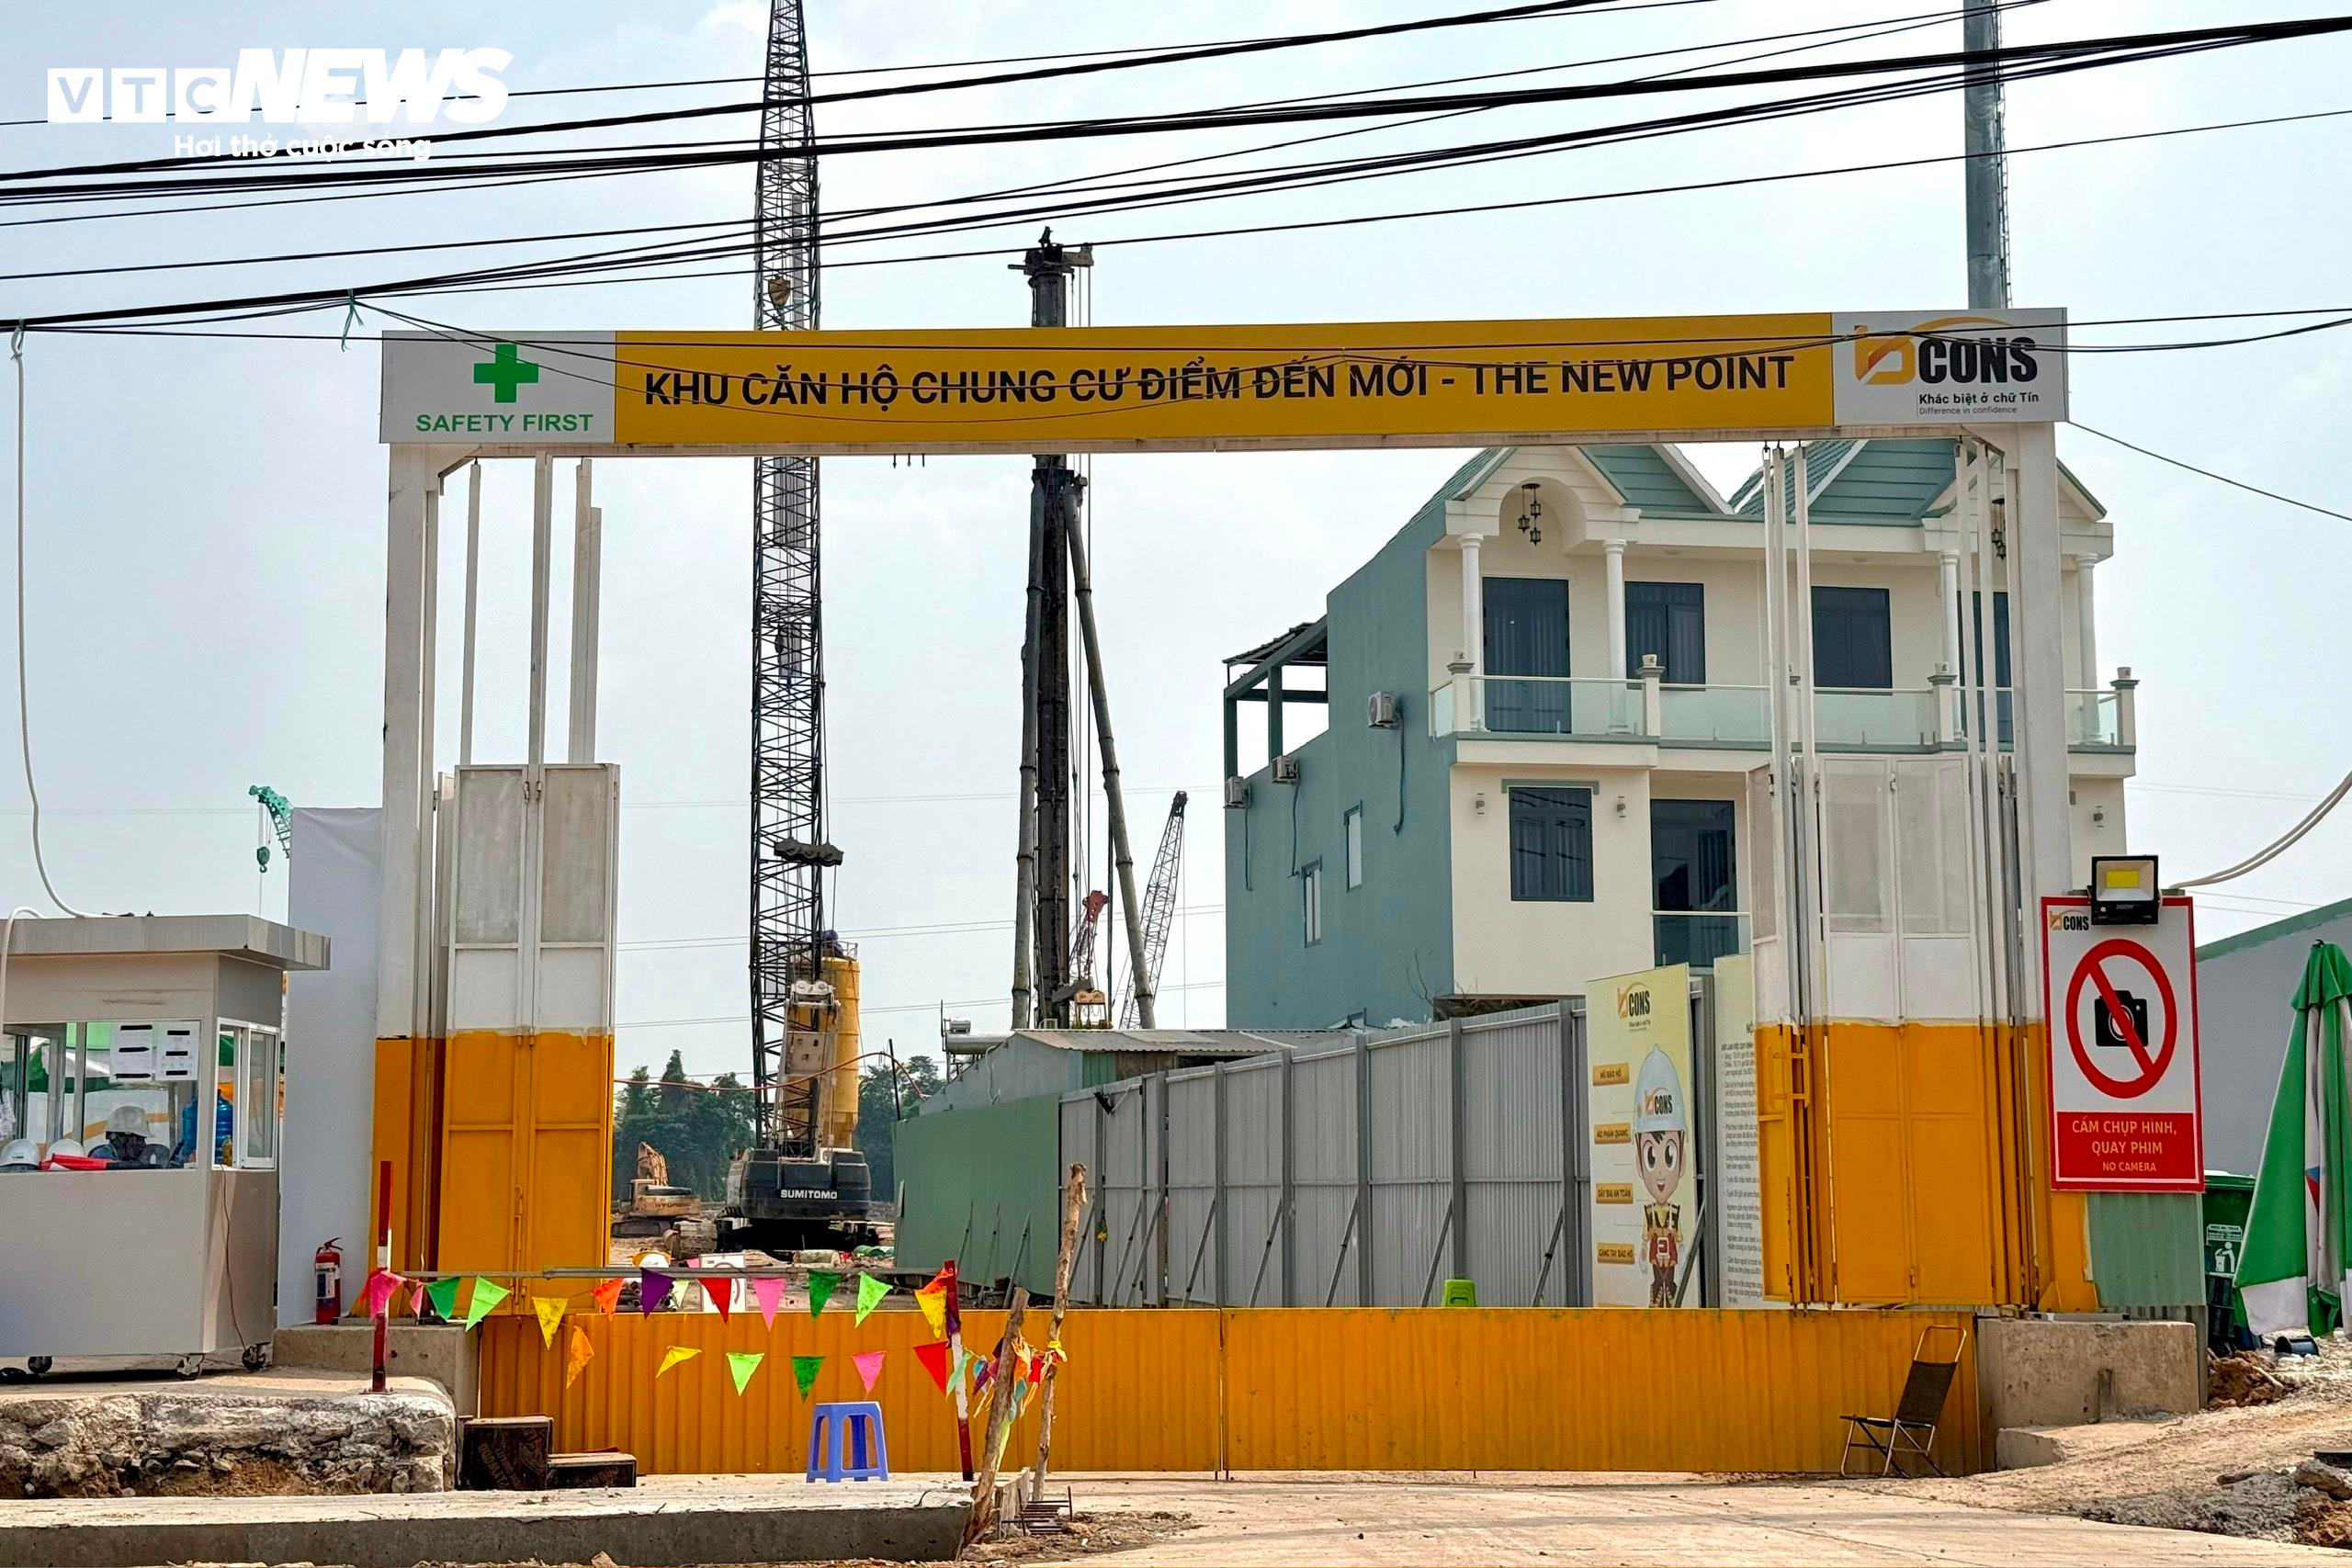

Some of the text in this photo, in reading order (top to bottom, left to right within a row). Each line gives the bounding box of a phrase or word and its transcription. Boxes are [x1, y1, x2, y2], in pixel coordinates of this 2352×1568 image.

[645, 371, 729, 405] KHU
[741, 363, 827, 405] CĂN
[841, 364, 898, 412] HỘ
[911, 368, 1057, 404] CHUNG
[1069, 367, 1131, 401] CƯ
[1136, 355, 1240, 400] ĐIỂM
[1252, 355, 1335, 399] ĐẾN
[1349, 355, 1427, 398] MỚI
[1471, 361, 1549, 395] THE
[1561, 358, 1653, 393] NEW
[1667, 355, 1794, 391] POINT
[1918, 390, 2039, 406] Khác biệt ở chữ Tín
[1918, 405, 2018, 415] Difference in confidence
[415, 413, 594, 433] SAFETY FIRST
[2072, 1114, 2177, 1136] CẤM CHỤP HÌNH,
[2091, 1140, 2163, 1156] QUAY PHIM
[2102, 1161, 2156, 1172] NO CAMERA
[780, 1189, 838, 1200] SUMITOMO
